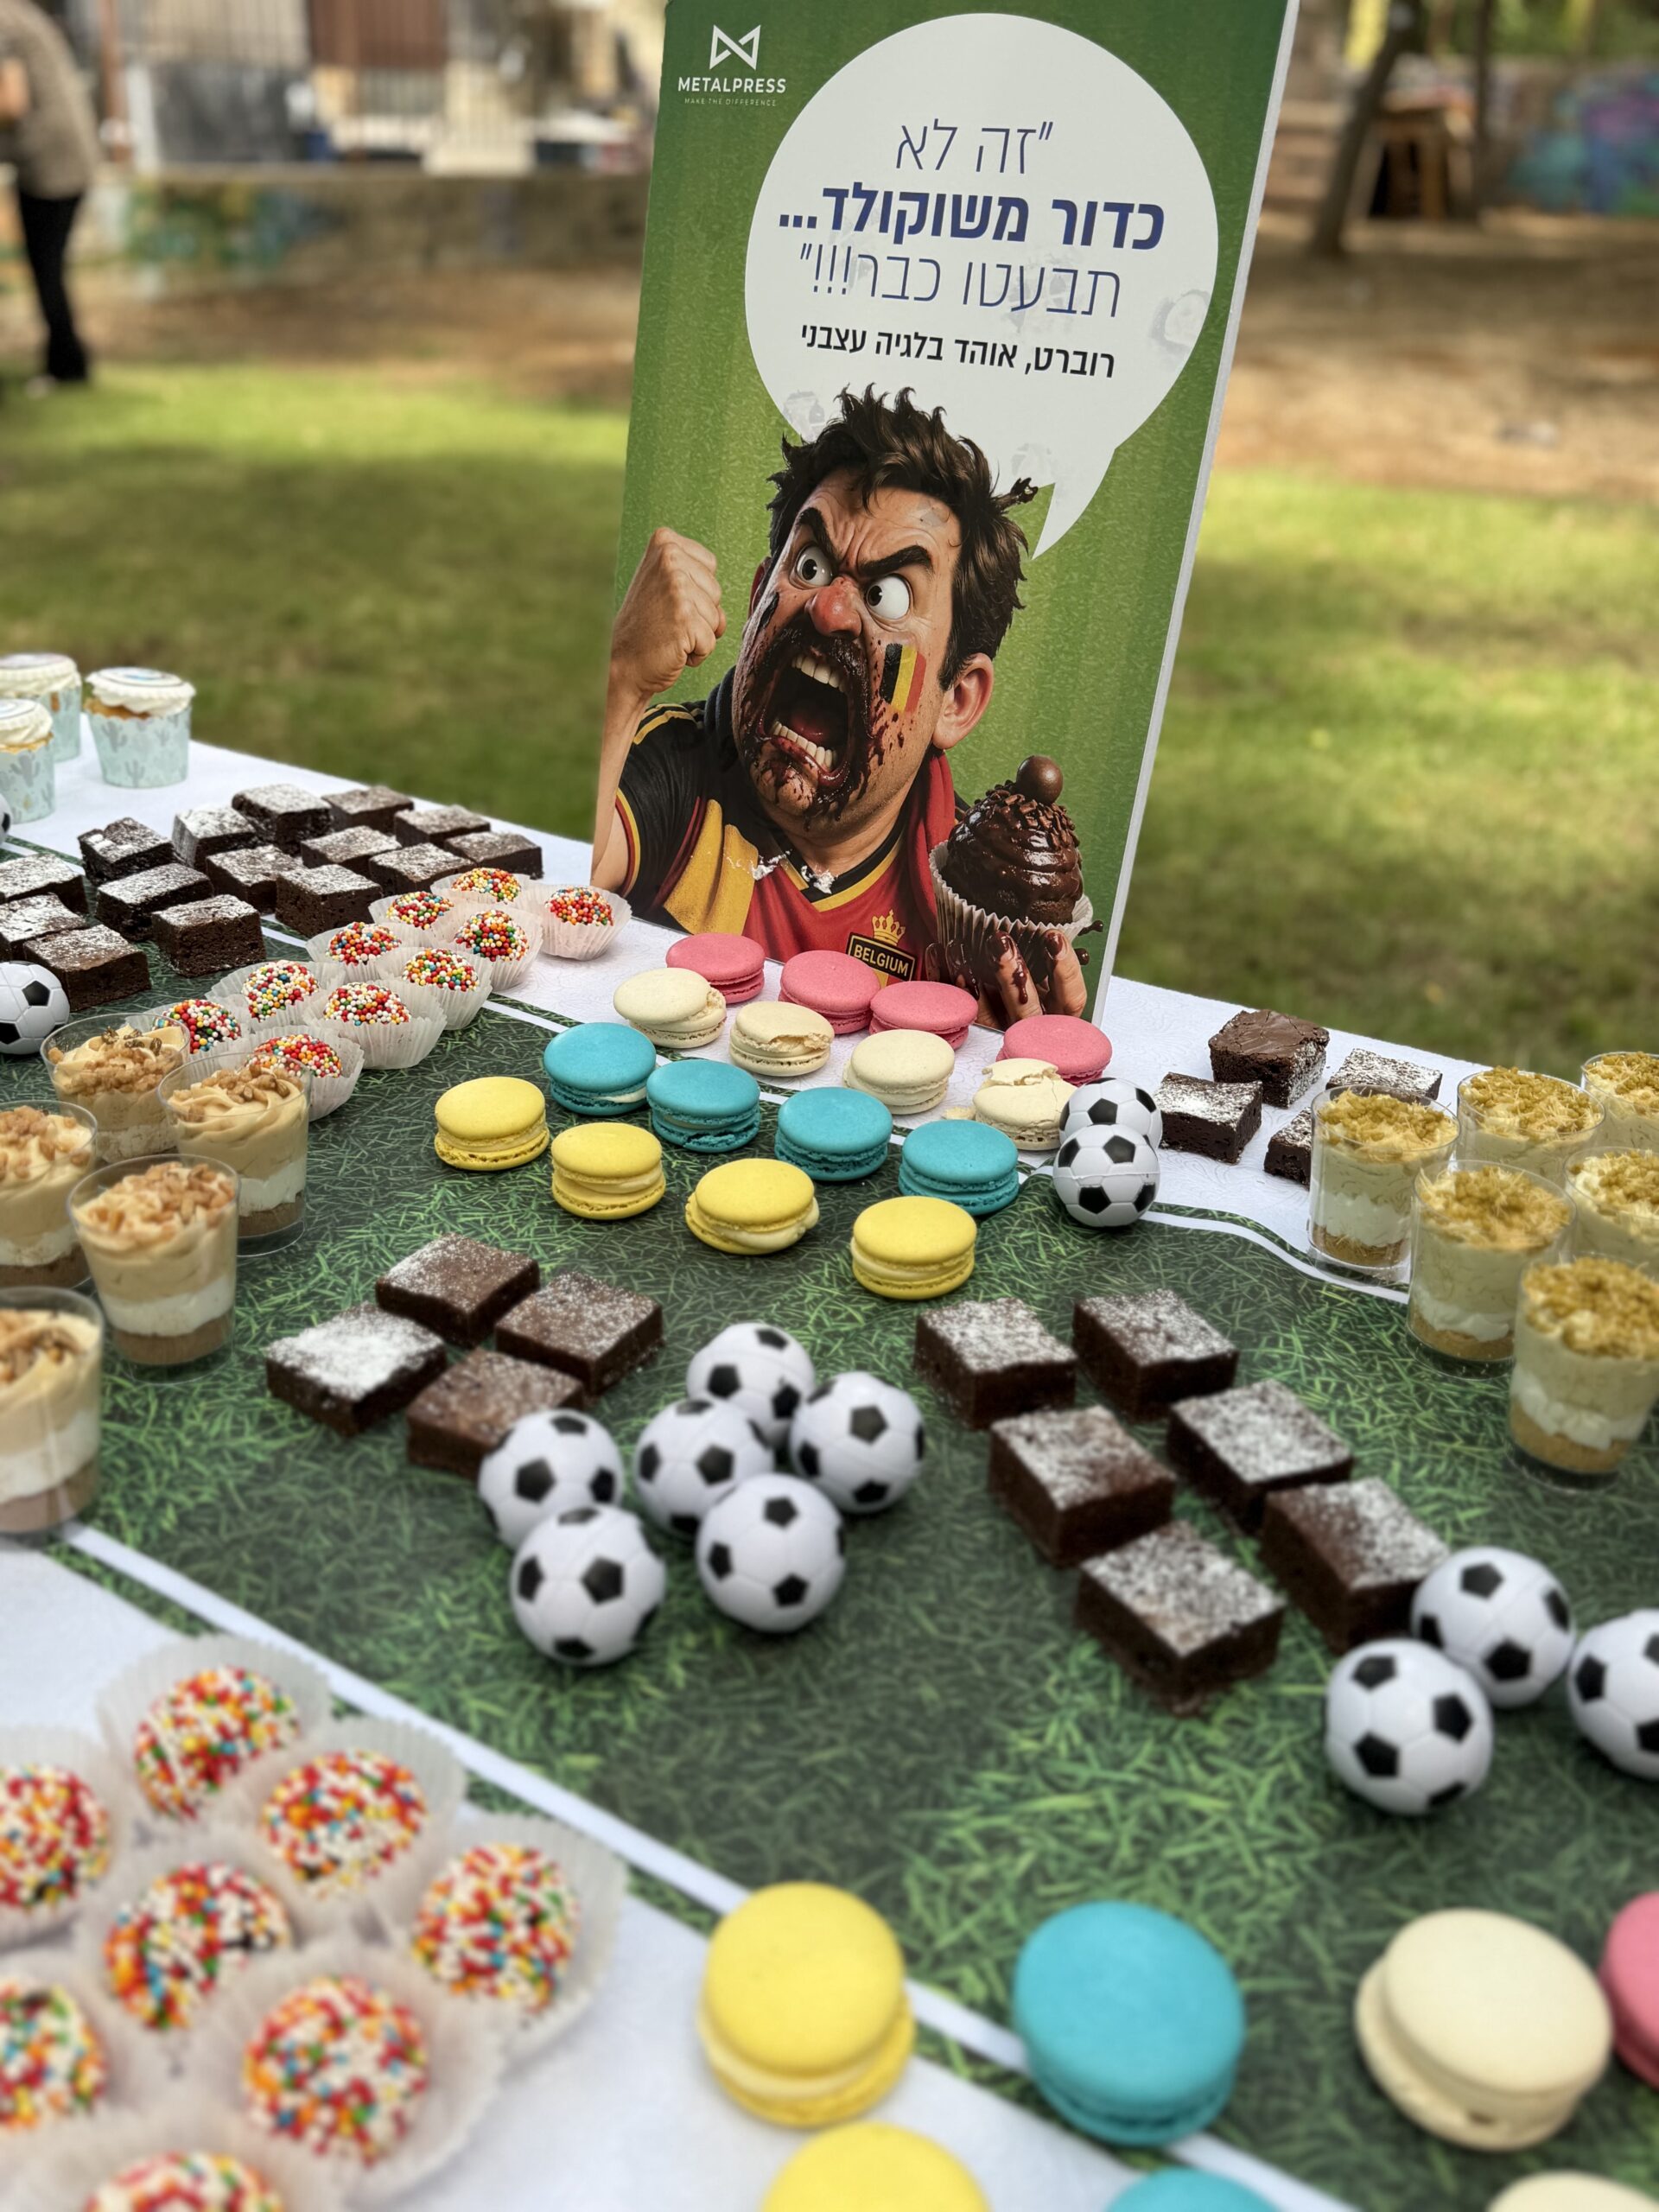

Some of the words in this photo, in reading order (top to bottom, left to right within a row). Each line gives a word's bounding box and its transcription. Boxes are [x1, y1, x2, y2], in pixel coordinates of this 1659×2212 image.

[677, 77, 787, 93] METALPRESS
[895, 118, 958, 171] לא
[779, 181, 1030, 245] משוקולד...
[1051, 198, 1166, 251] כדור
[962, 260, 1122, 318] תבעטו
[800, 324, 868, 353] עצבני
[874, 331, 944, 361] בלגיה
[953, 338, 1018, 369] אוהד
[1024, 346, 1116, 378] רוברט,
[854, 944, 909, 976] BELGIUM
